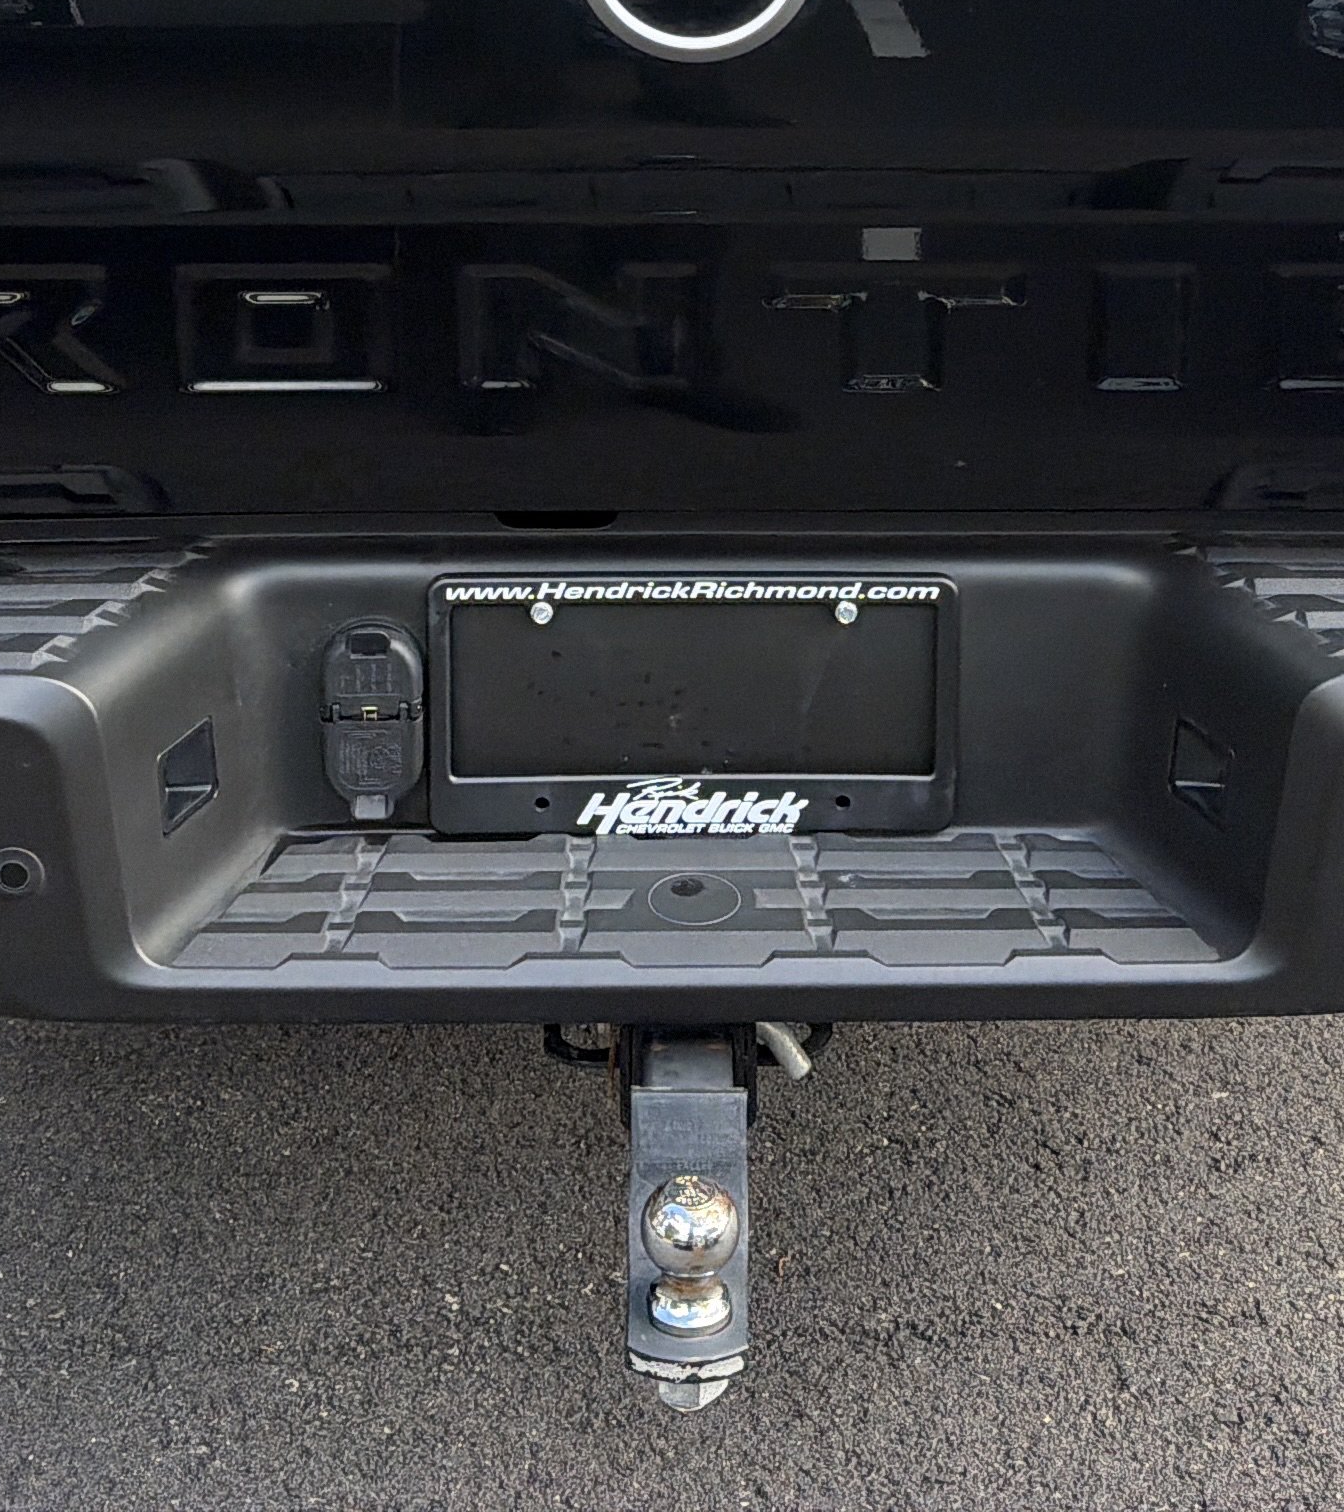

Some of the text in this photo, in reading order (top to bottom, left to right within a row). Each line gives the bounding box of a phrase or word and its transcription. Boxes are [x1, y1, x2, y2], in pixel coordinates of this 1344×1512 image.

[445, 581, 940, 601] www.HendrickRichmond.com
[576, 791, 809, 835] Hendrick
[615, 822, 795, 835] CHEVROLET BUICK GMC
